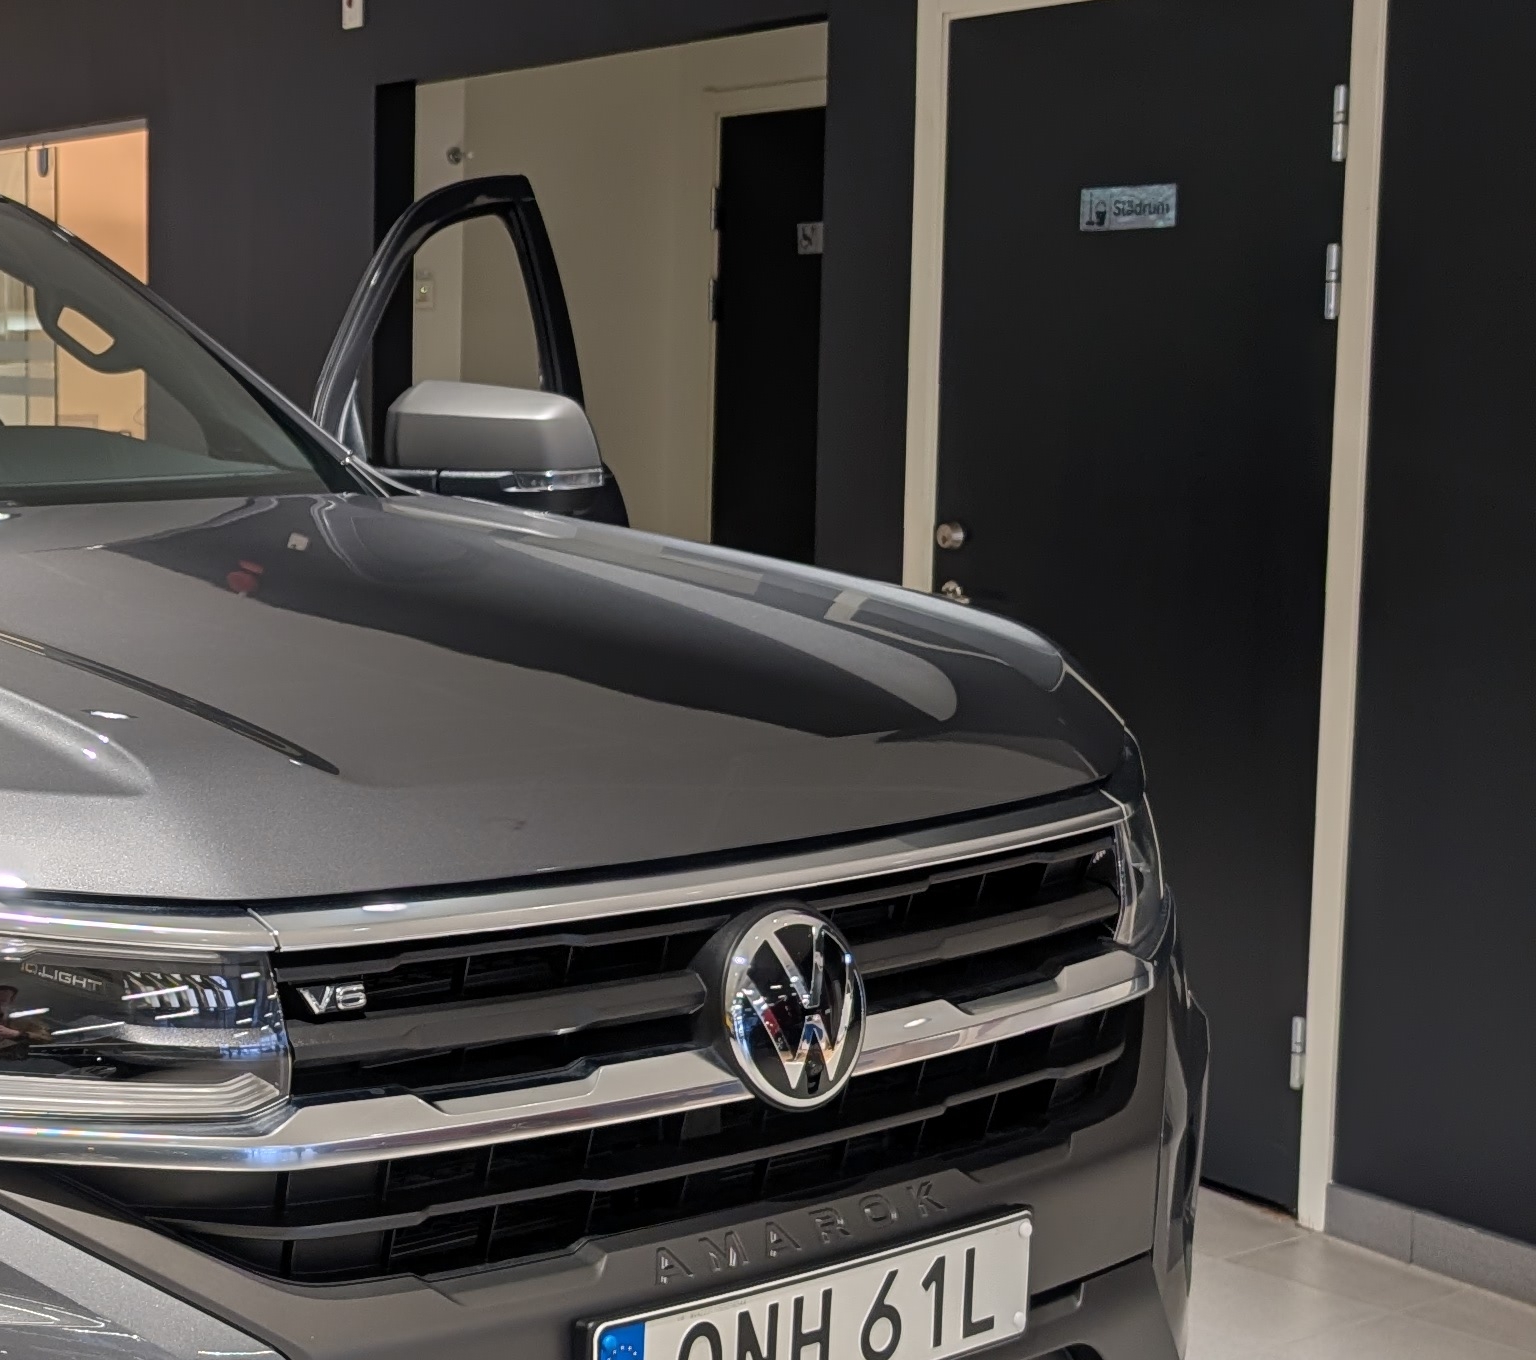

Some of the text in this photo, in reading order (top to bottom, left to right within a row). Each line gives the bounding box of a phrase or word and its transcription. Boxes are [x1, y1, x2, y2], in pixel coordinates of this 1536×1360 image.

[1113, 198, 1170, 217] Städrum
[296, 982, 367, 1015] V6
[655, 1179, 946, 1286] AMAROK
